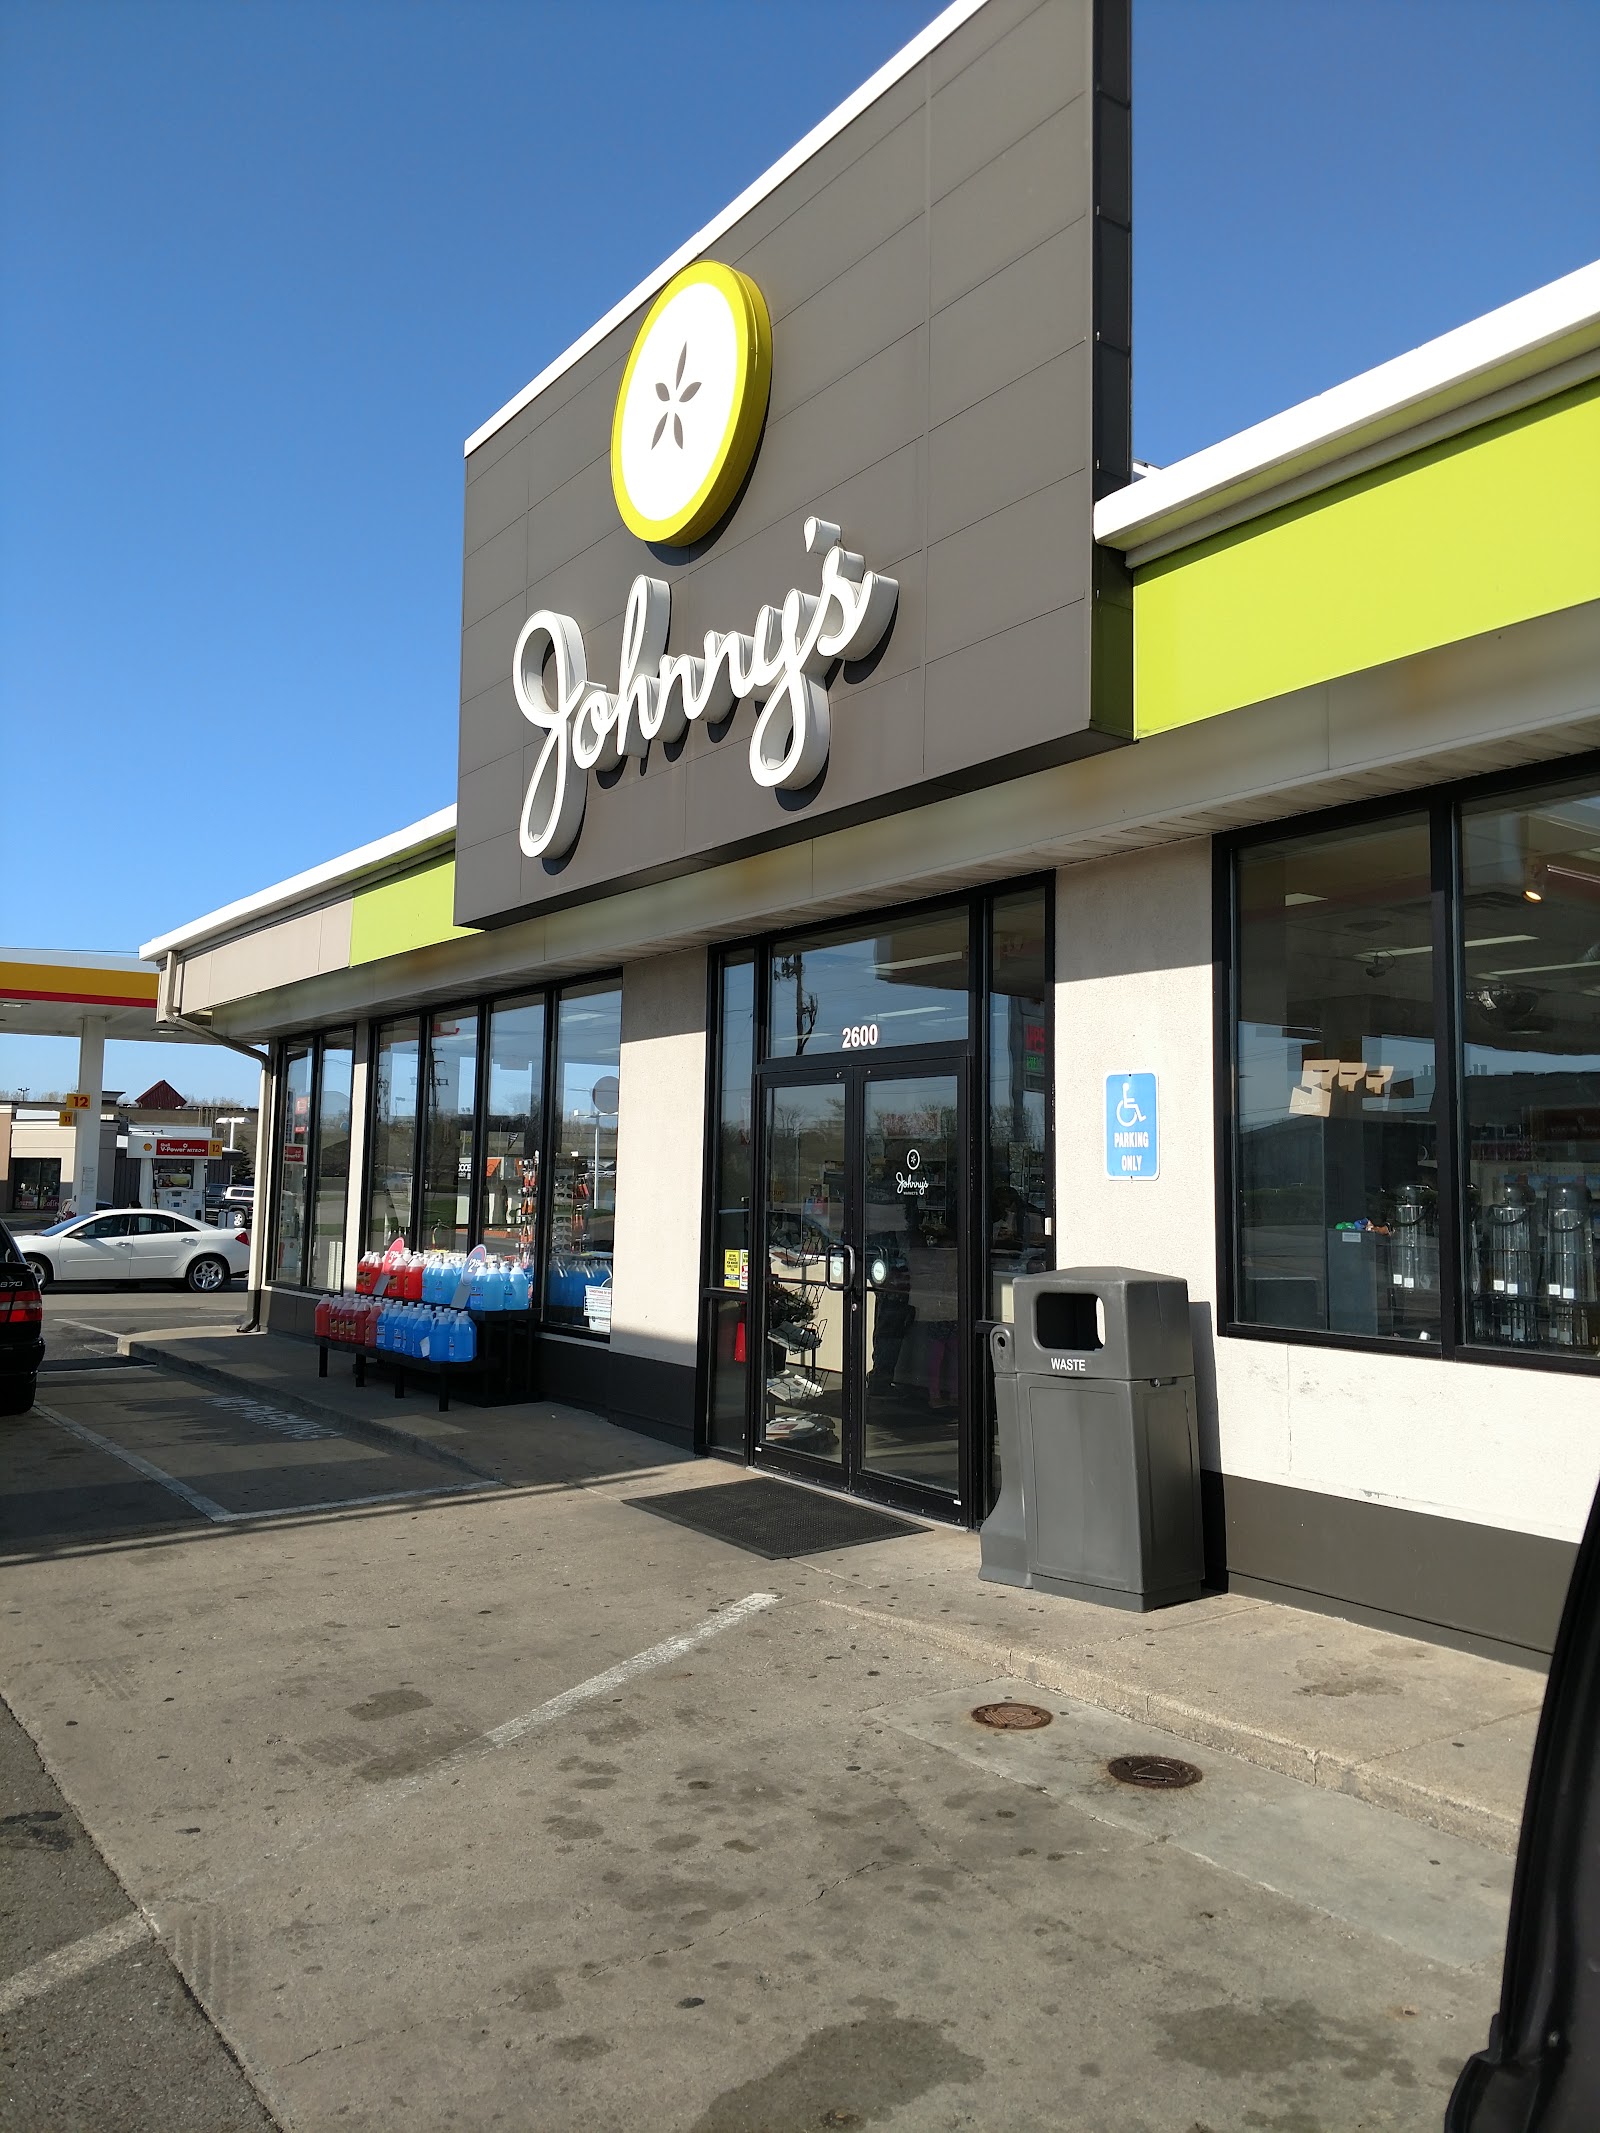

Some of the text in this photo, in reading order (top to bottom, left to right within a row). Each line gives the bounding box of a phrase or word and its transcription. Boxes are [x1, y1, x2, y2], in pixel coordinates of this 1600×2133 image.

[512, 515, 899, 861] Johnny's
[842, 1023, 878, 1049] 2600
[74, 1096, 89, 1107] 12
[1114, 1131, 1149, 1148] PARKING
[212, 1144, 220, 1153] 12
[1121, 1154, 1143, 1171] ONLY
[895, 1171, 929, 1196] Johnny's
[1051, 1357, 1086, 1371] WASTE
